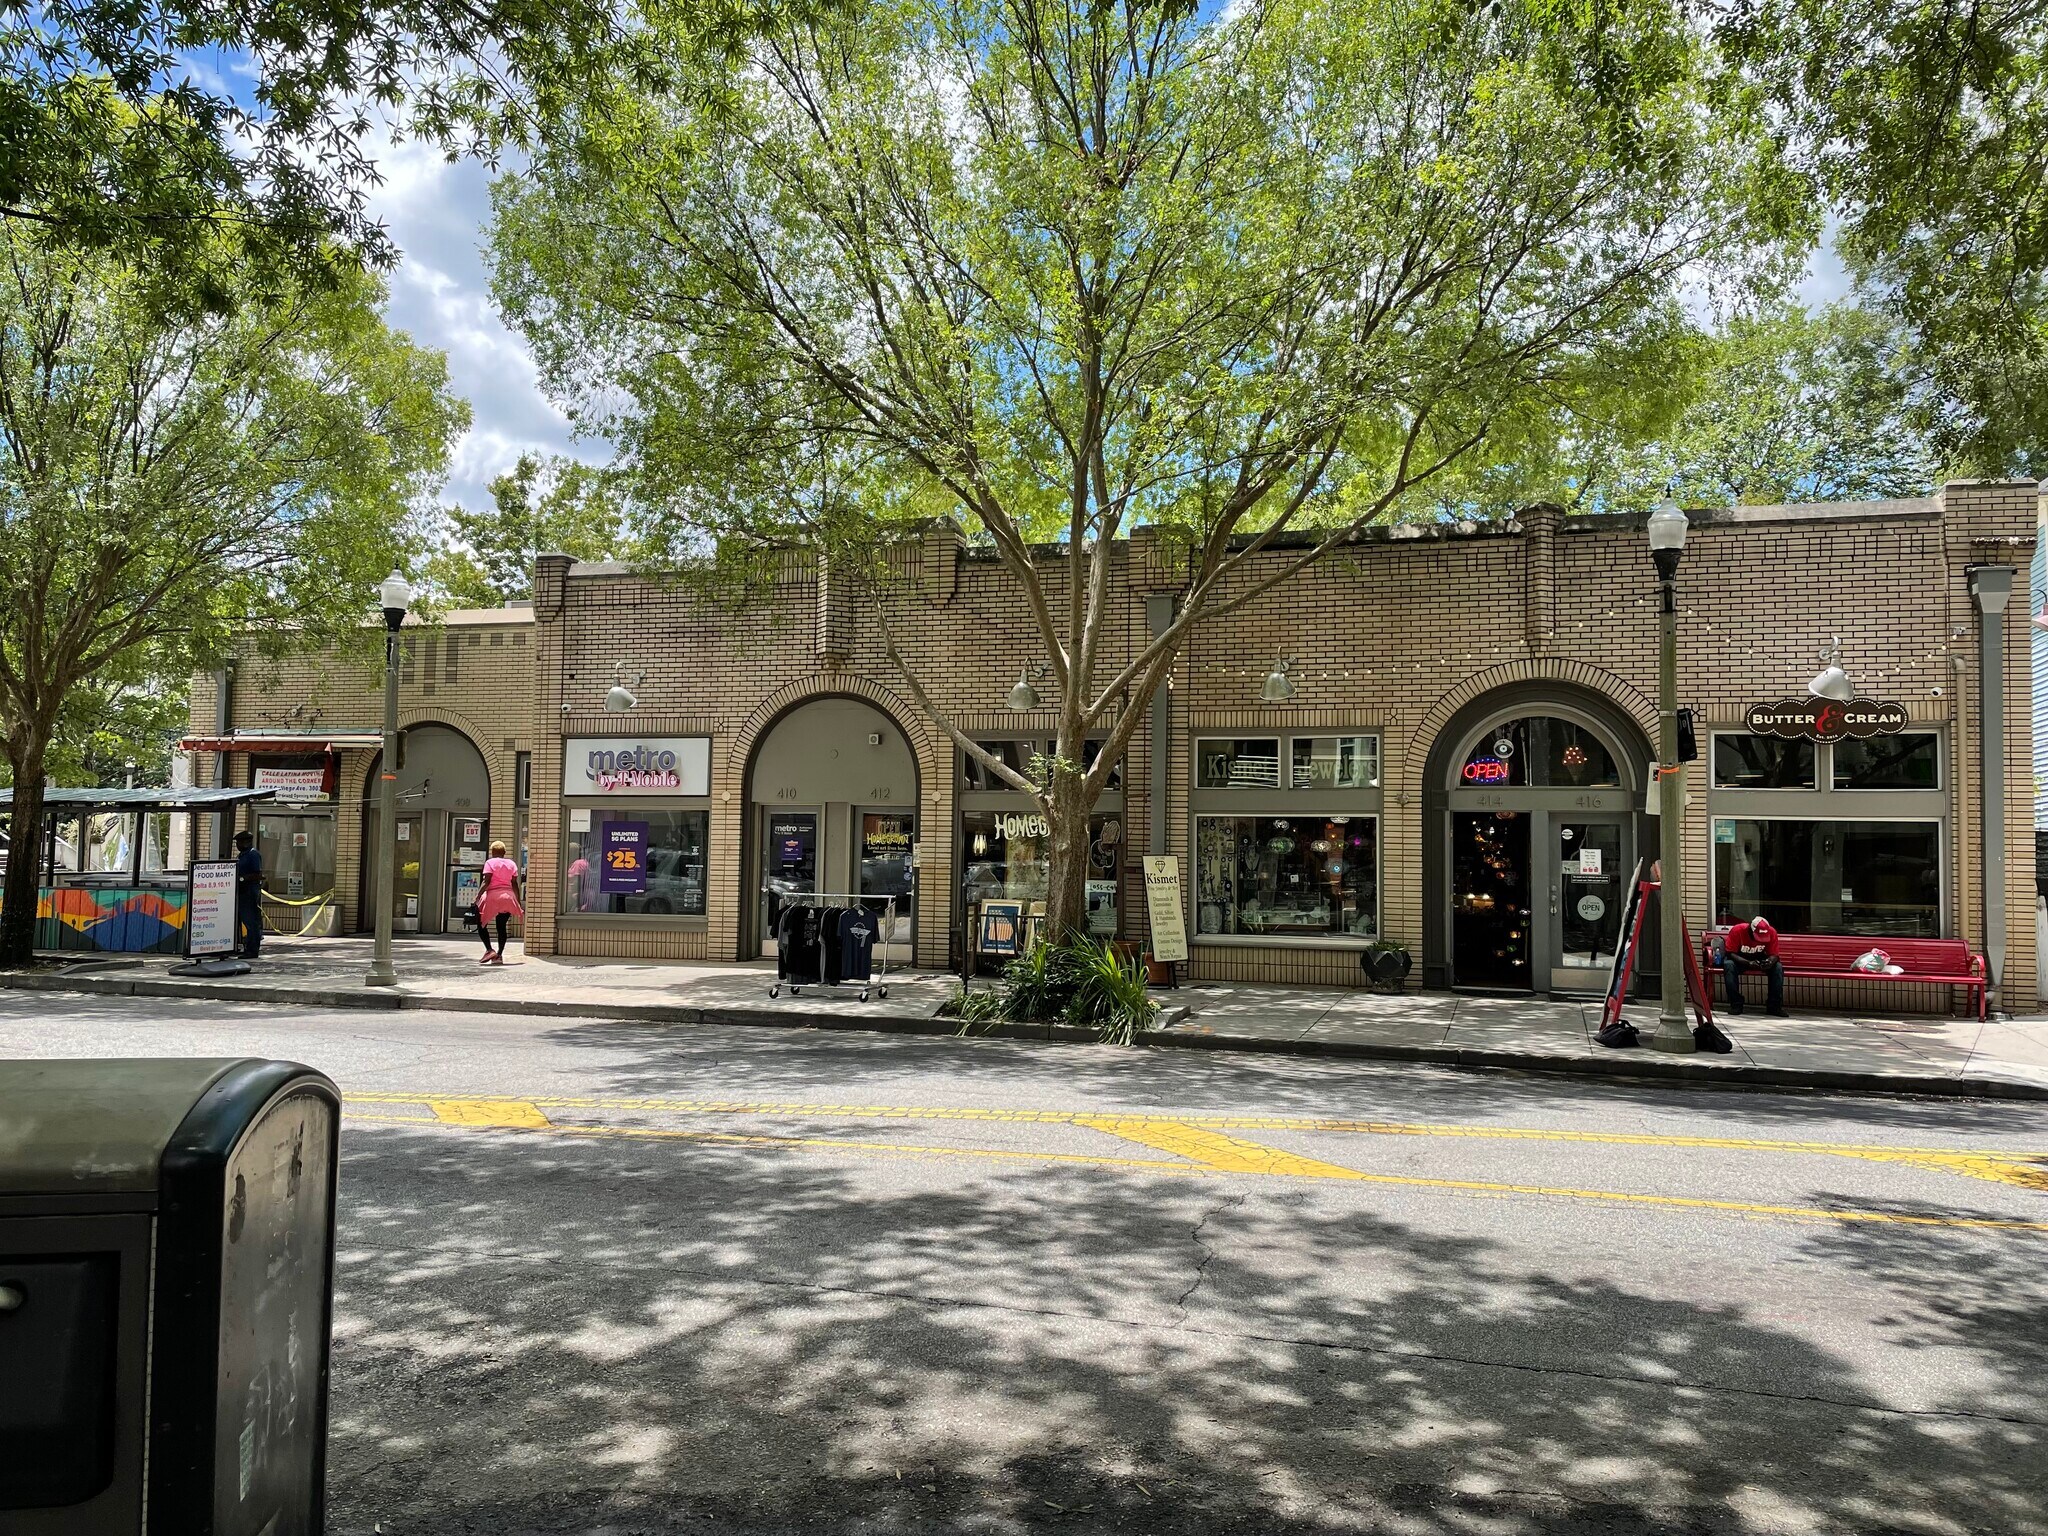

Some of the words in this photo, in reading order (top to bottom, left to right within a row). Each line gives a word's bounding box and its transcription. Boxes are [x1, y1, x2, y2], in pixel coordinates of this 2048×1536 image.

[1752, 714, 1816, 724] BUTTER
[1816, 704, 1844, 734] &
[1844, 713, 1902, 724] CREAM
[588, 745, 676, 770] metro
[1206, 754, 1273, 779] Kismet
[1297, 754, 1377, 779] Jewelers
[1464, 763, 1508, 778] OPEN
[597, 771, 616, 791] by
[776, 788, 797, 800] 410
[870, 788, 890, 799] 412
[1476, 795, 1503, 807] 414
[1575, 795, 1602, 808] 416
[774, 824, 798, 832] metro
[606, 850, 636, 869] $25
[1146, 872, 1178, 884] Kismet
[1582, 904, 1600, 912] OPEN
